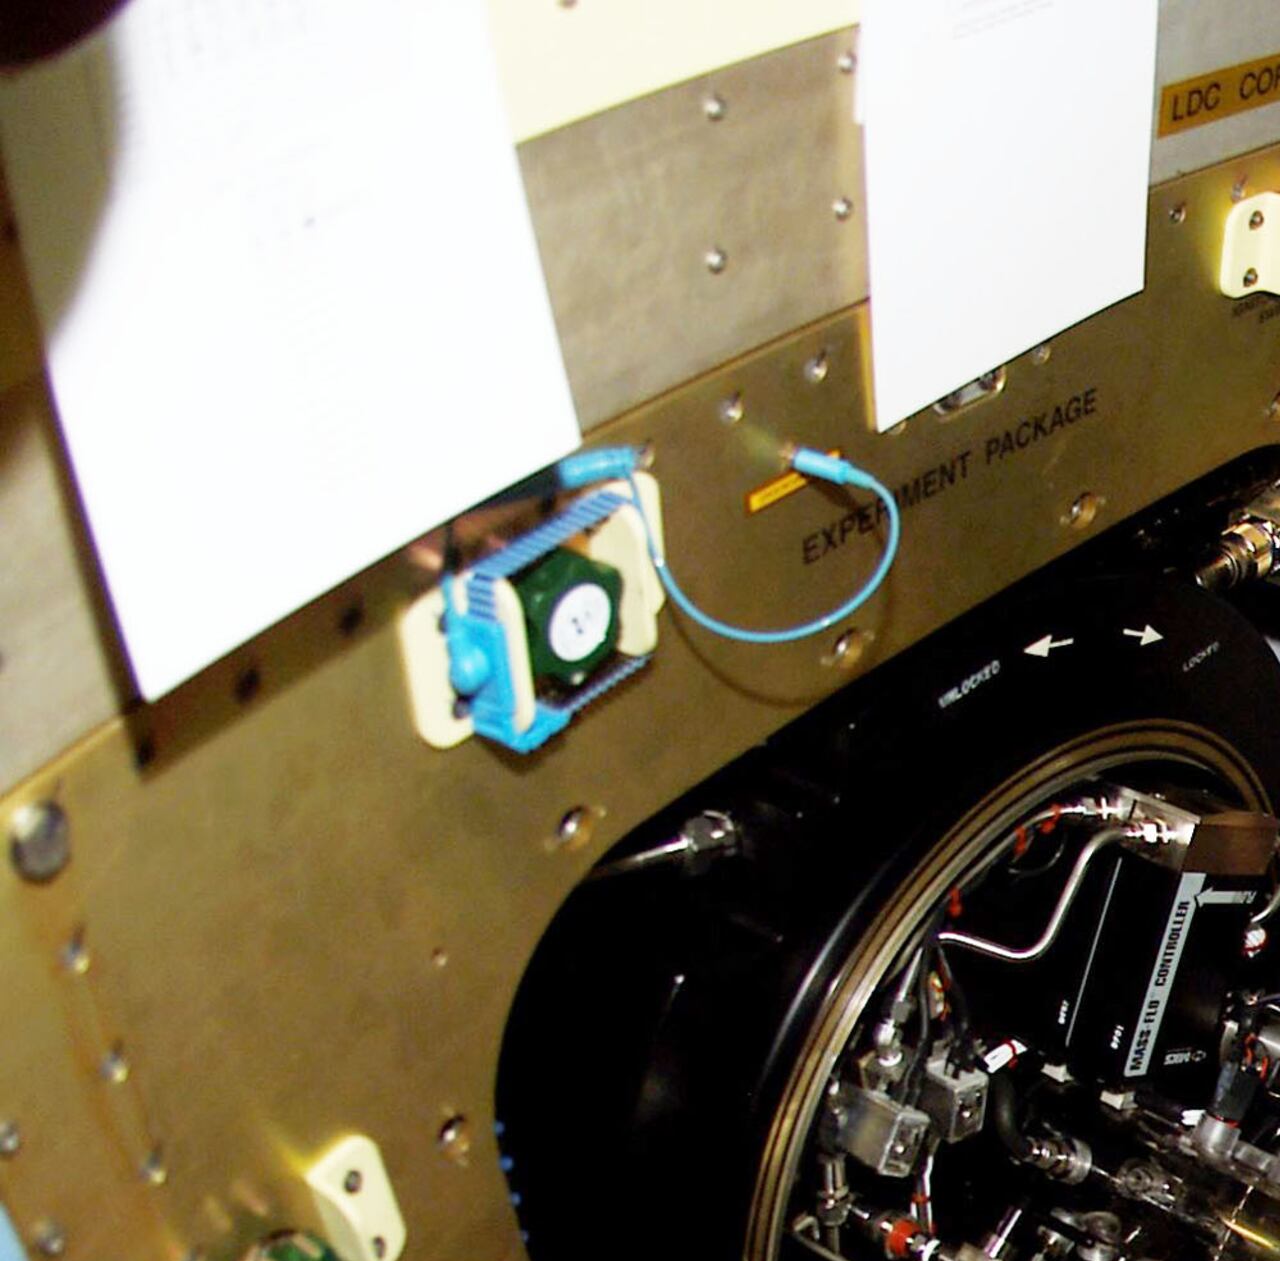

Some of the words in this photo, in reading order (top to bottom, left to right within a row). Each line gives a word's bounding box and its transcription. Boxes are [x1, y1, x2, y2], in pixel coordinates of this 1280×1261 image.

[1171, 82, 1222, 122] LDC
[985, 388, 1098, 466] PACKAGE
[938, 660, 1000, 709] UNLOCKED
[1182, 641, 1221, 672] LOCKED
[1154, 901, 1191, 987] CONTROLLER
